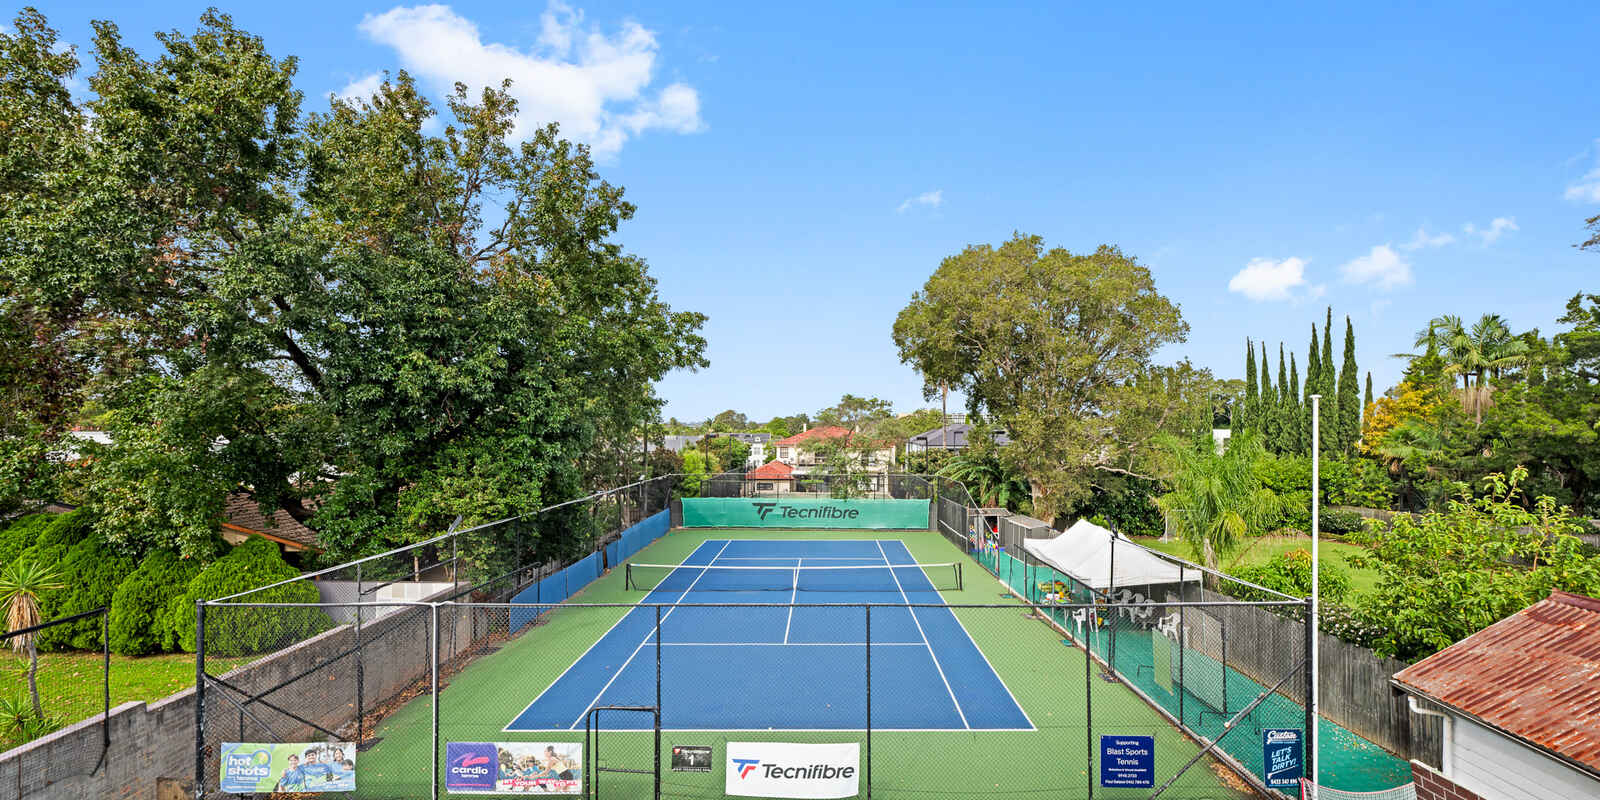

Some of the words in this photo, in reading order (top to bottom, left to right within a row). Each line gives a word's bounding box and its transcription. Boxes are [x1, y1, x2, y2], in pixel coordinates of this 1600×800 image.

[780, 506, 859, 519] Tecnifibre
[1125, 748, 1148, 756] Sports
[1272, 746, 1292, 758] LET'S
[229, 755, 252, 766] hot
[689, 754, 694, 766] 1
[1272, 754, 1290, 764] TALK
[228, 766, 268, 776] shots
[452, 767, 489, 775] cardio
[762, 764, 854, 779] Tecnifibre
